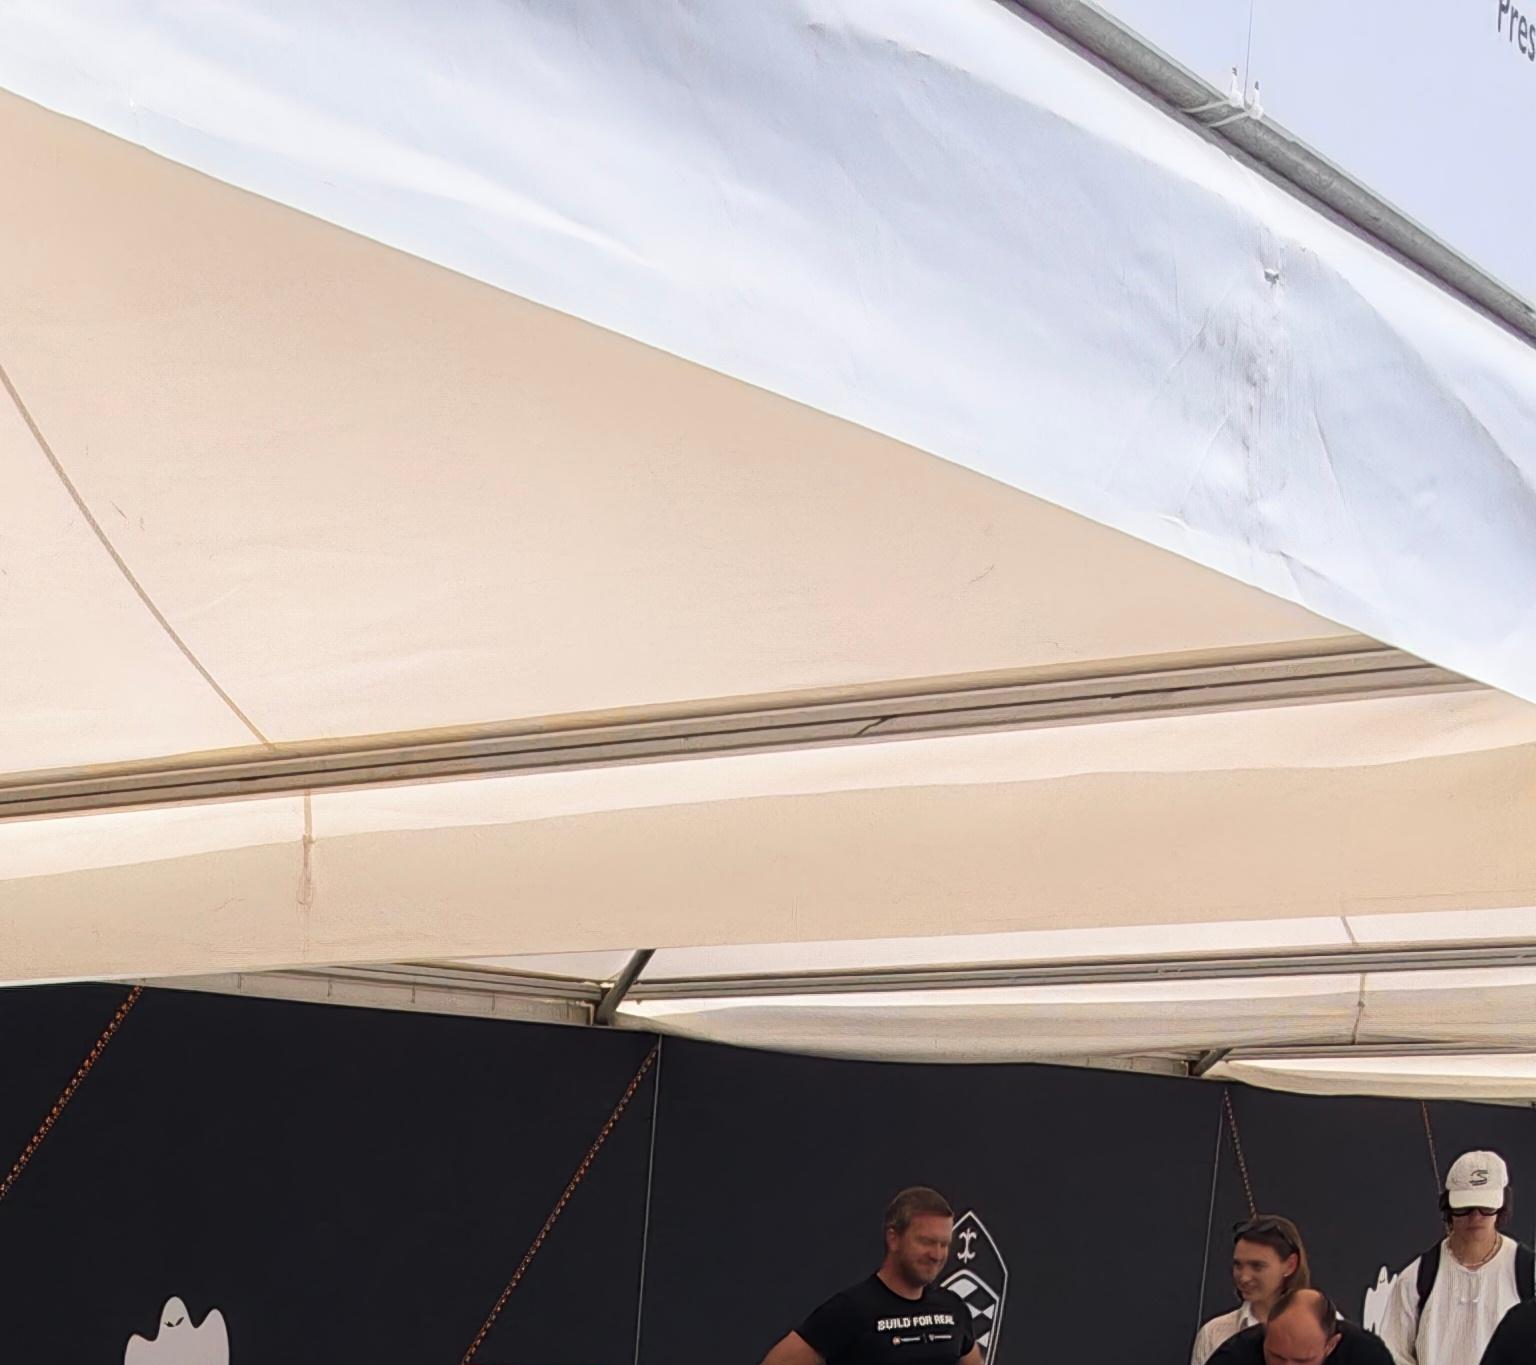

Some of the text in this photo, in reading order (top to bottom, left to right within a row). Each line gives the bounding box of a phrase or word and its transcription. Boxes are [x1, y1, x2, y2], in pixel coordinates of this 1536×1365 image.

[877, 1314, 955, 1332] BUILD FOR REAL
